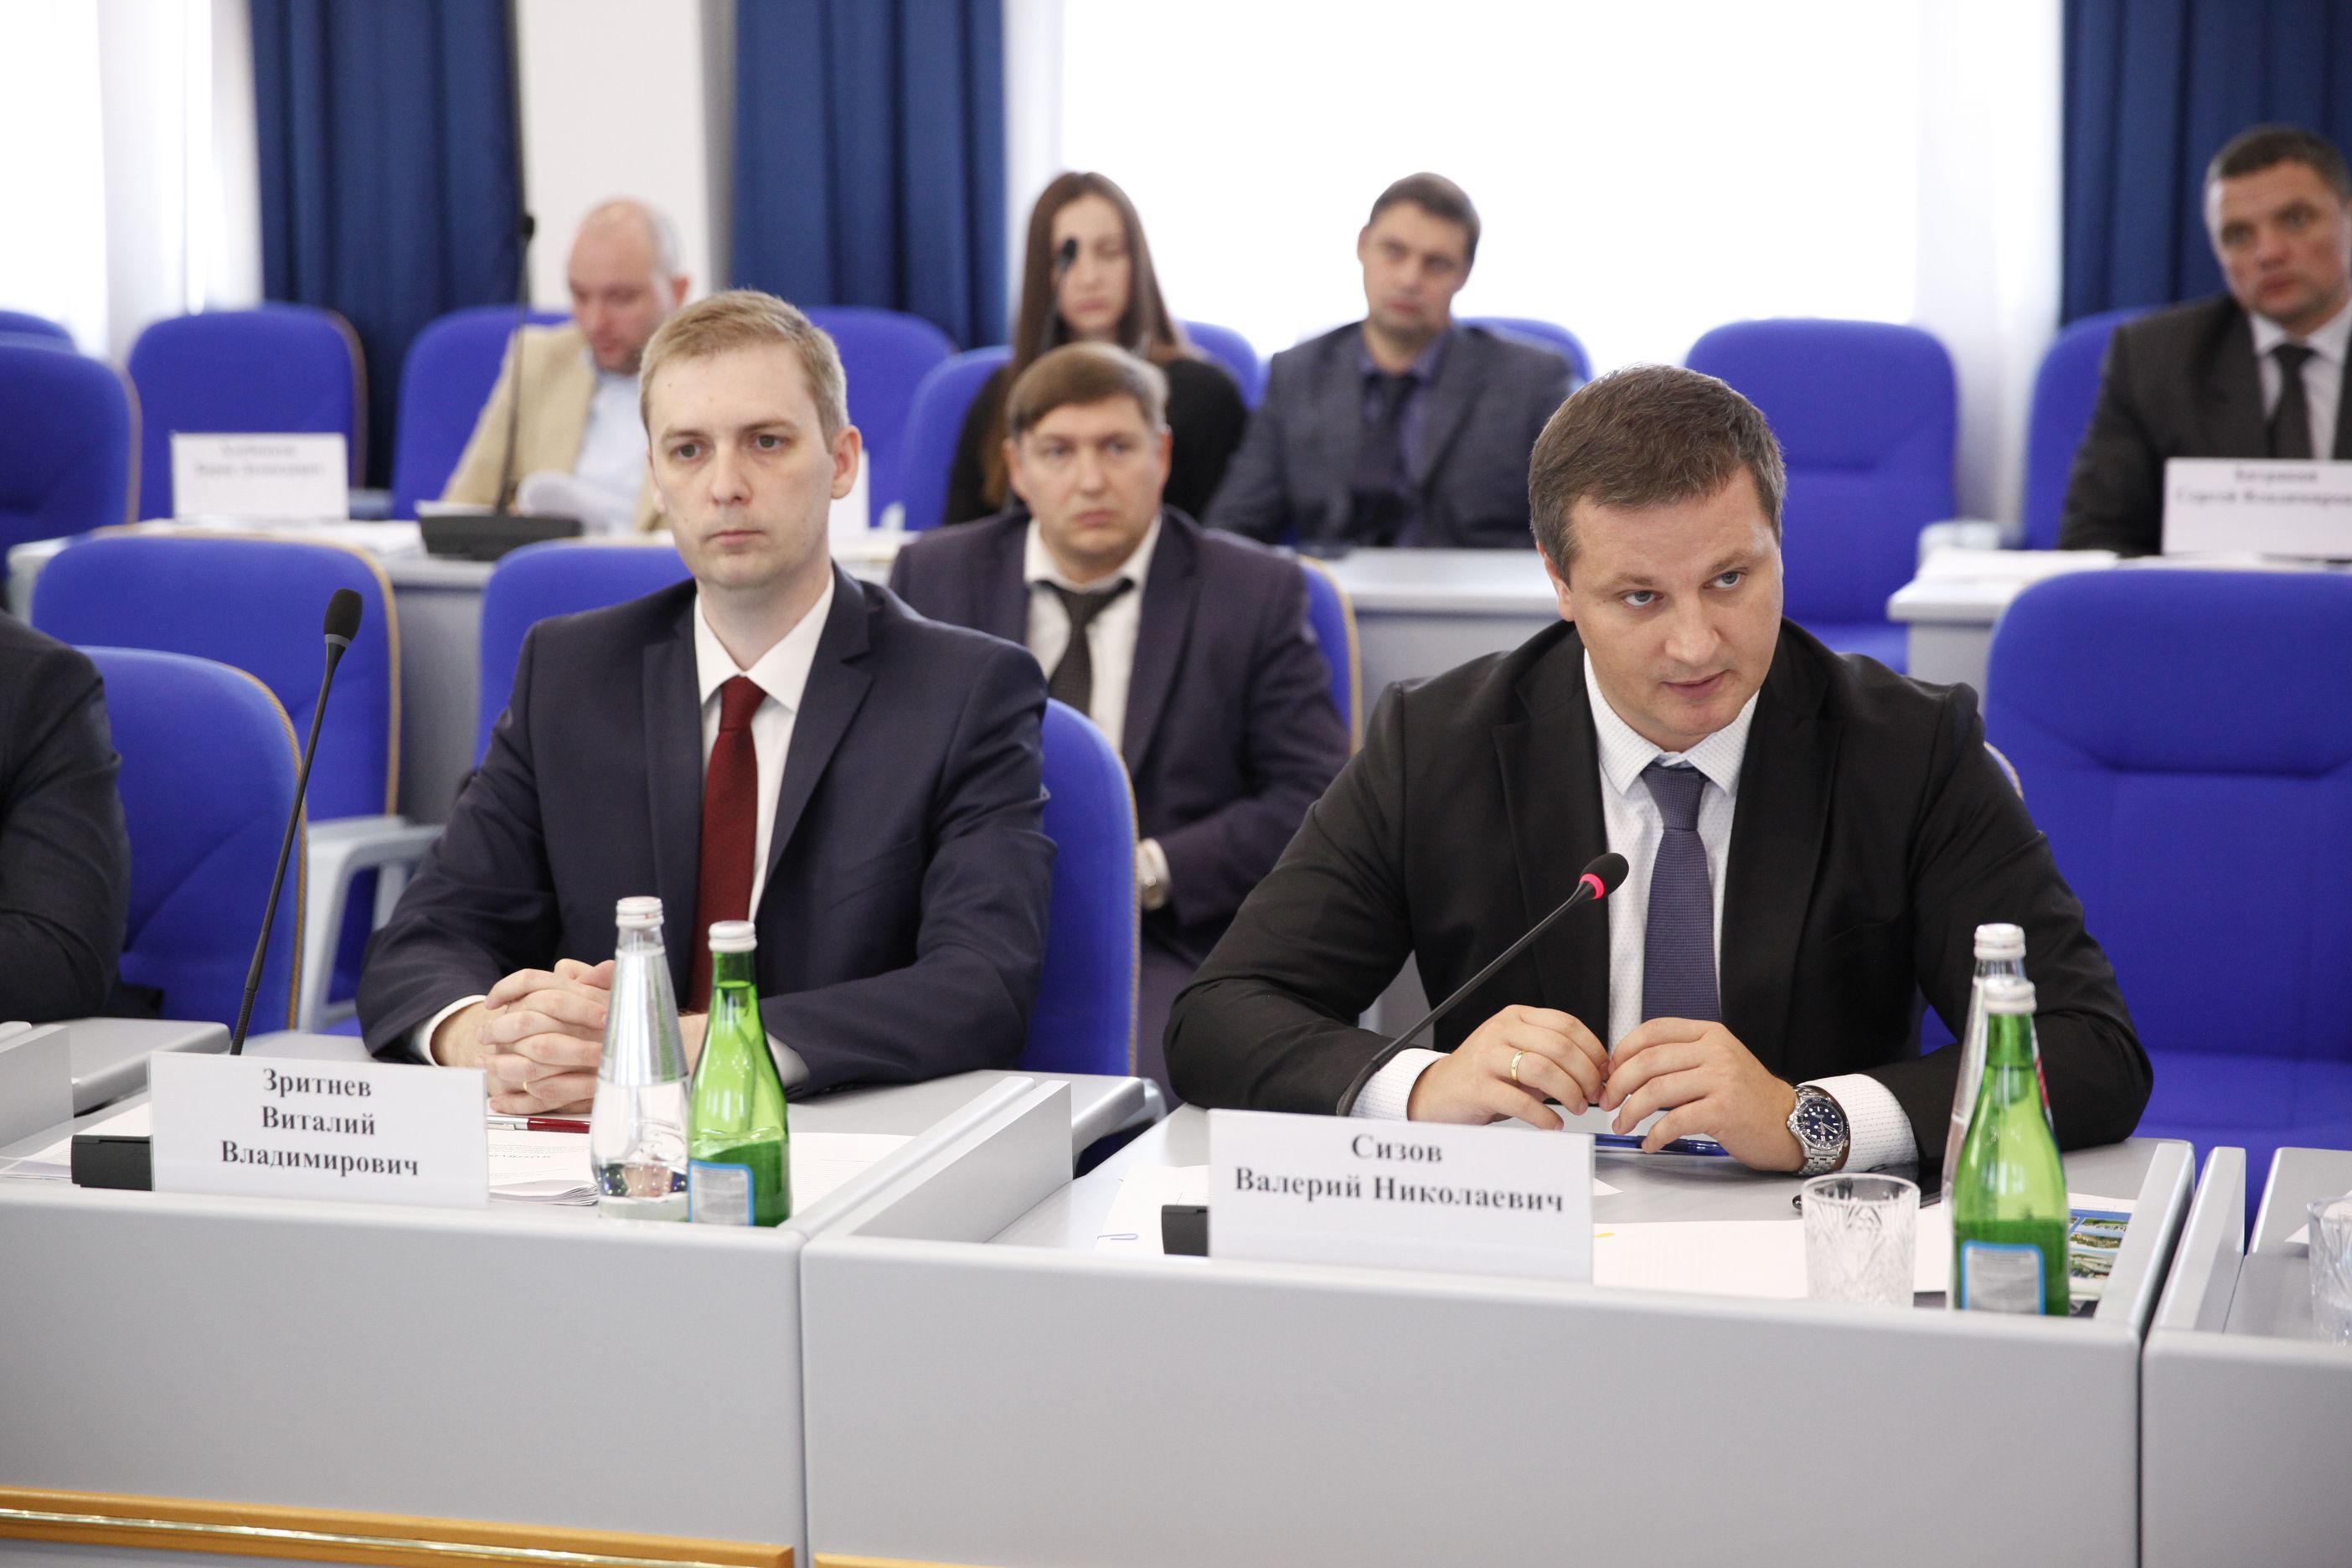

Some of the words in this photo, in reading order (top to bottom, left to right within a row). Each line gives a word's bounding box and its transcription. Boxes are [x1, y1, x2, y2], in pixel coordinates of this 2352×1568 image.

[263, 1067, 372, 1098] Зритнев
[261, 1105, 376, 1136] Виталий
[220, 1139, 420, 1178] Владимирович
[1350, 1133, 1443, 1163] Сизов
[1235, 1167, 1363, 1203] Валерий
[1373, 1175, 1564, 1213] Николаевич
